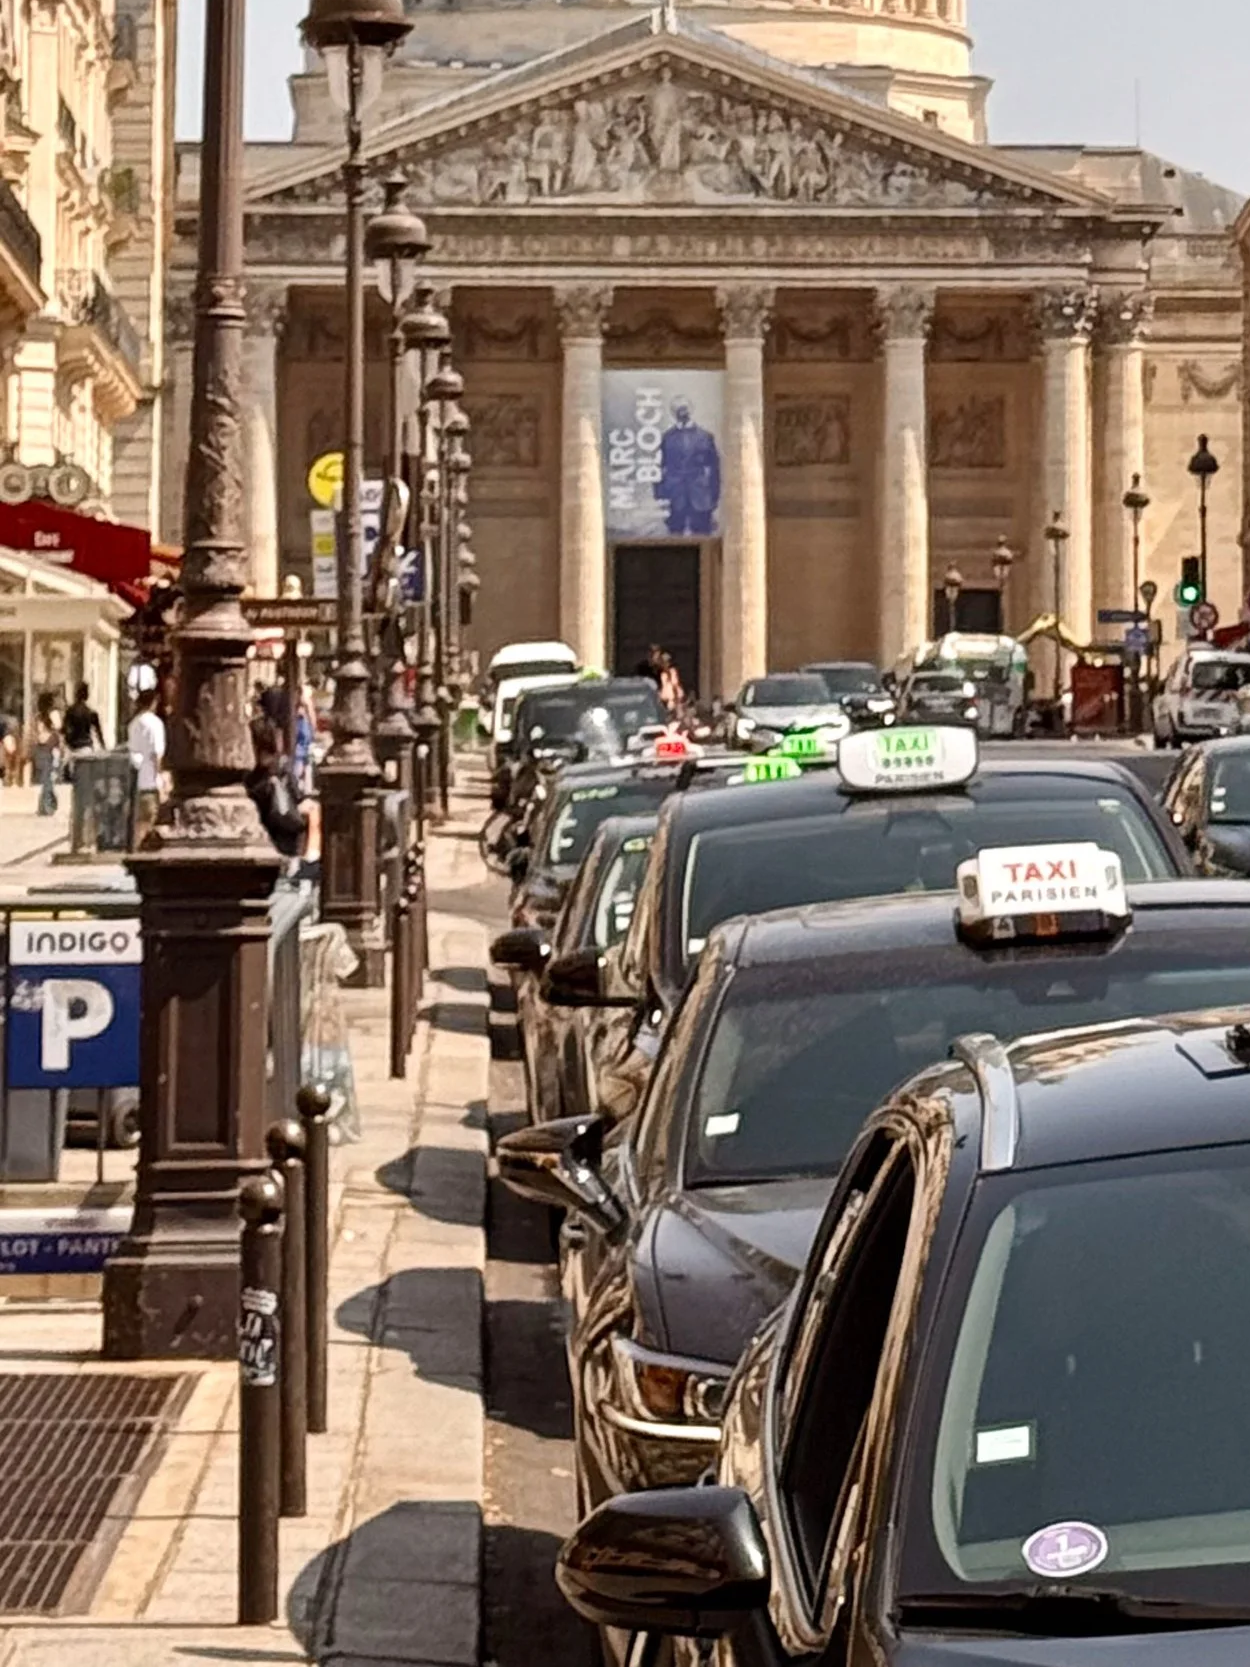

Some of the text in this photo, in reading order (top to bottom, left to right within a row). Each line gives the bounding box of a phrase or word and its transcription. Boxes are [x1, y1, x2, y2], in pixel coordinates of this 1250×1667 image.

[635, 387, 662, 483] BLOCH
[609, 427, 636, 509] MARC
[882, 733, 929, 752] TAXI
[991, 886, 1098, 904] PARISIEN
[1003, 859, 1077, 883] TAXI
[41, 978, 114, 1071] P
